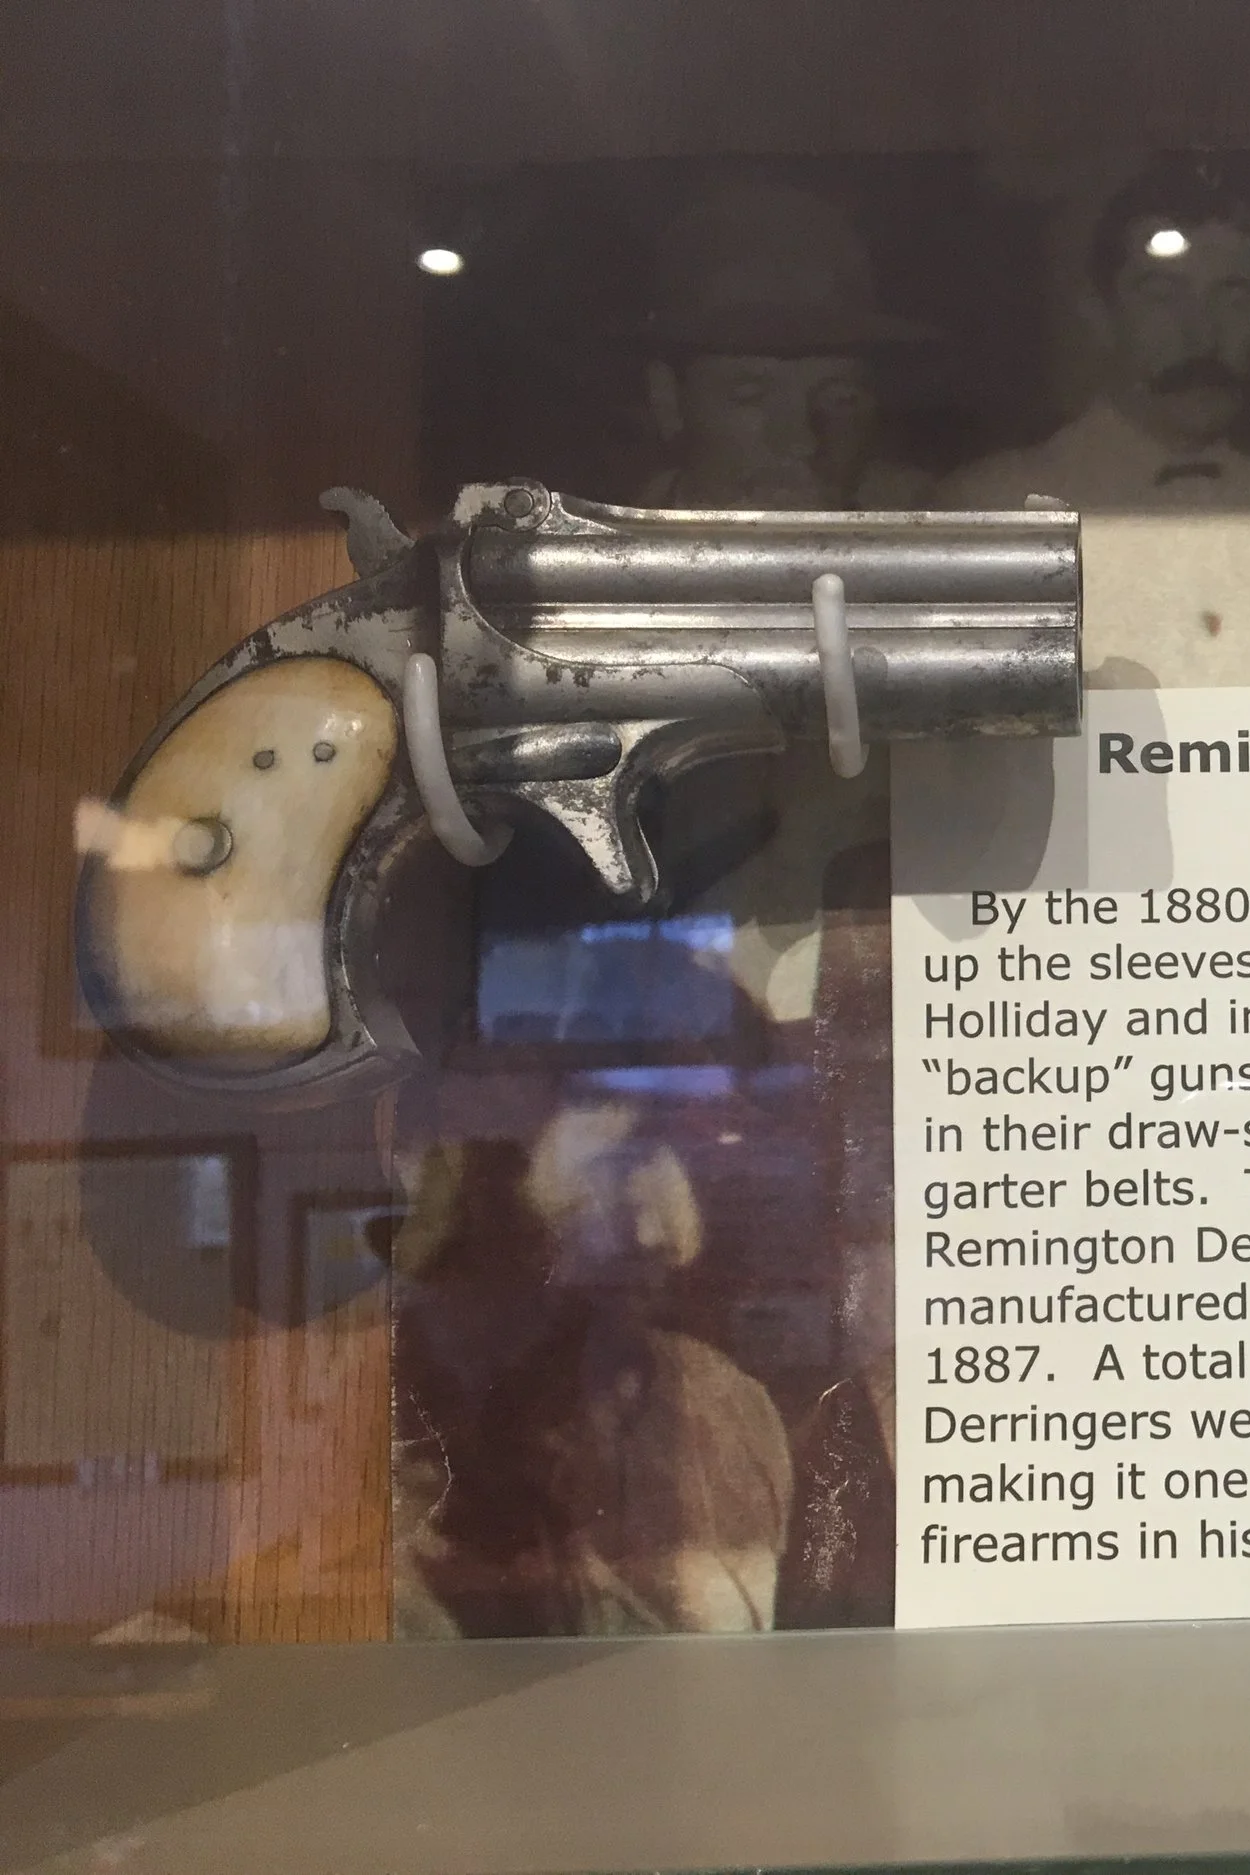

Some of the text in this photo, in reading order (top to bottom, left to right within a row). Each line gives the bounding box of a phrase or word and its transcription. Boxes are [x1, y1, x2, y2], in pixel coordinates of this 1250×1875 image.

[970, 888, 1027, 935] By
[1045, 887, 1118, 926] the
[924, 954, 979, 992] up
[997, 944, 1071, 982] the
[925, 999, 1108, 1046] Holliday
[1126, 997, 1208, 1037] and
[925, 1116, 963, 1153] in
[982, 1113, 1092, 1152] their
[924, 1173, 1067, 1220] garter
[1085, 1168, 1208, 1208] belts.
[926, 1229, 1174, 1275] Remington
[925, 1281, 1247, 1326] manufactured
[927, 1345, 1055, 1385] 1887.
[1092, 1343, 1125, 1381] A
[1142, 1339, 1246, 1381] total
[925, 1404, 1172, 1451] Derringers
[923, 1462, 1094, 1511] making
[1116, 1462, 1146, 1500] it
[1164, 1468, 1248, 1500] one
[920, 1523, 1119, 1564] firearms
[1139, 1521, 1177, 1560] in
